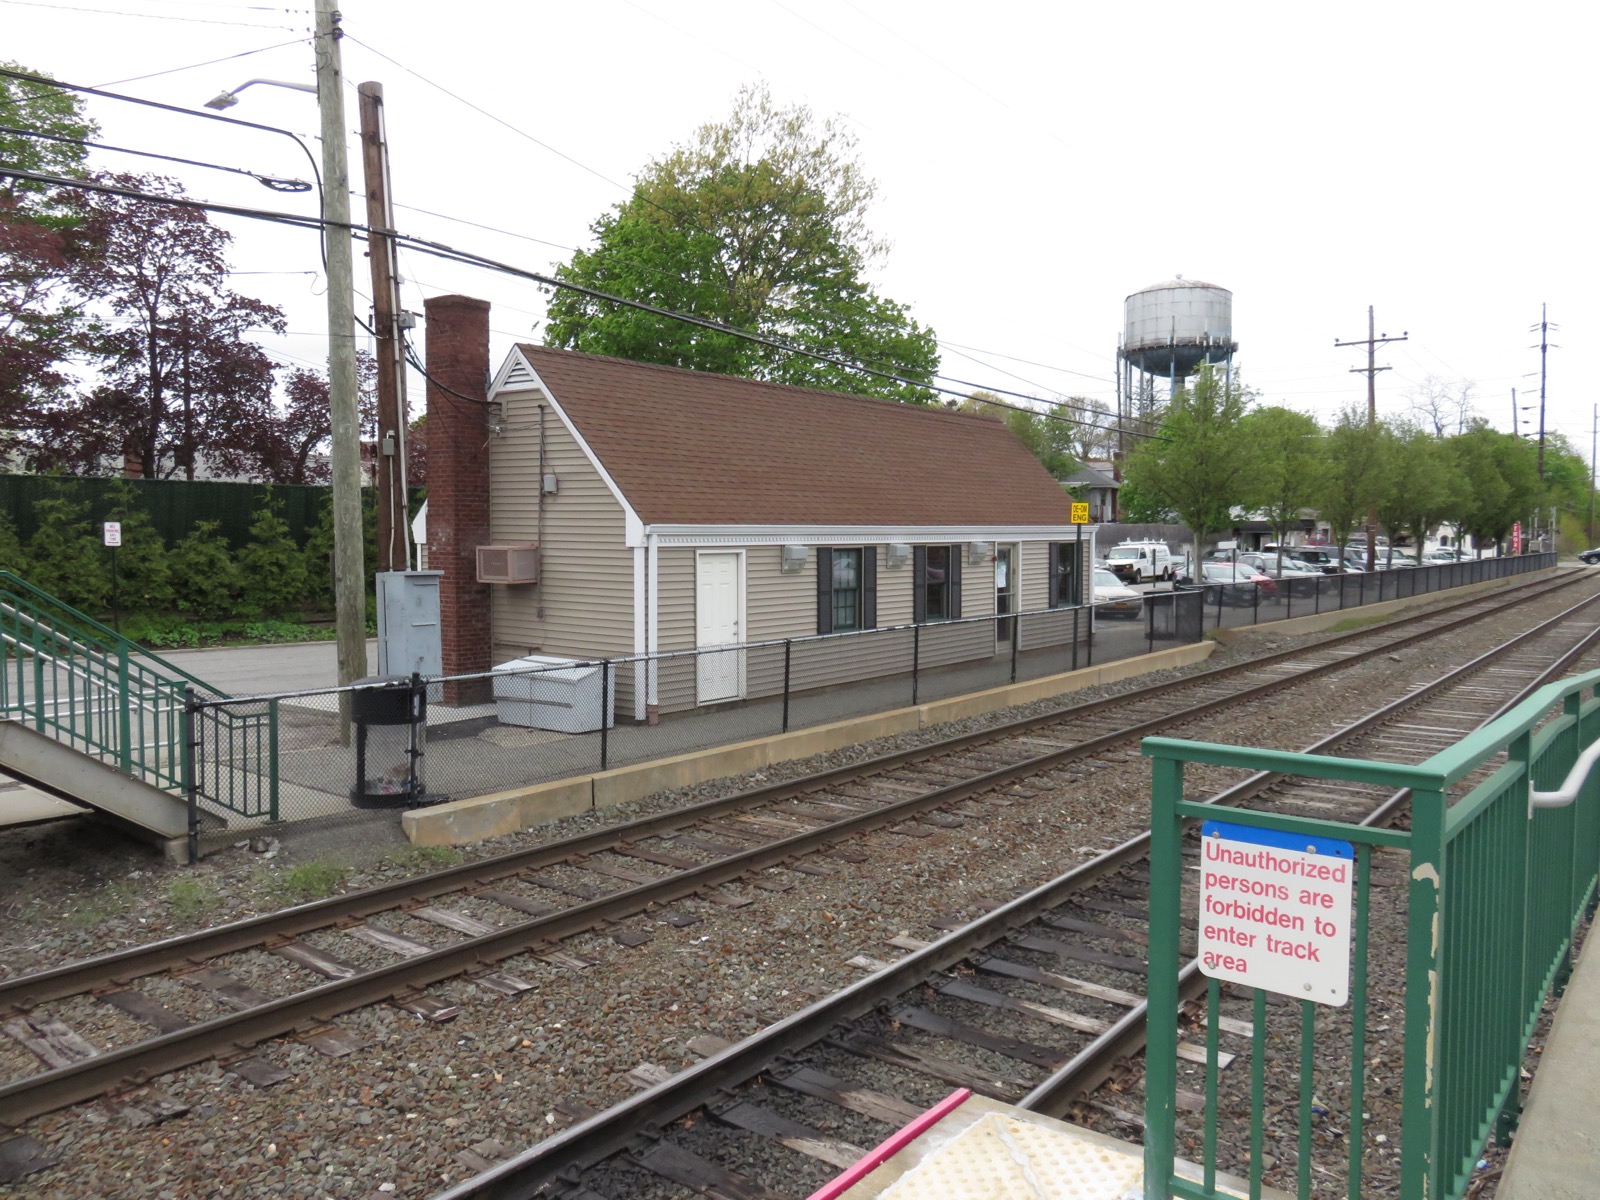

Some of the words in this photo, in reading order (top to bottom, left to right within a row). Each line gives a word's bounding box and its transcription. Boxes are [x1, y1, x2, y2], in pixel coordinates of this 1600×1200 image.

[1205, 841, 1346, 884] Unauthorized
[1205, 872, 1289, 901] persons
[1298, 889, 1334, 909] are
[1205, 895, 1304, 931] forbidden
[1314, 917, 1337, 937] to
[1203, 951, 1247, 973] area
[1204, 925, 1256, 948] enter
[1266, 934, 1320, 962] track
